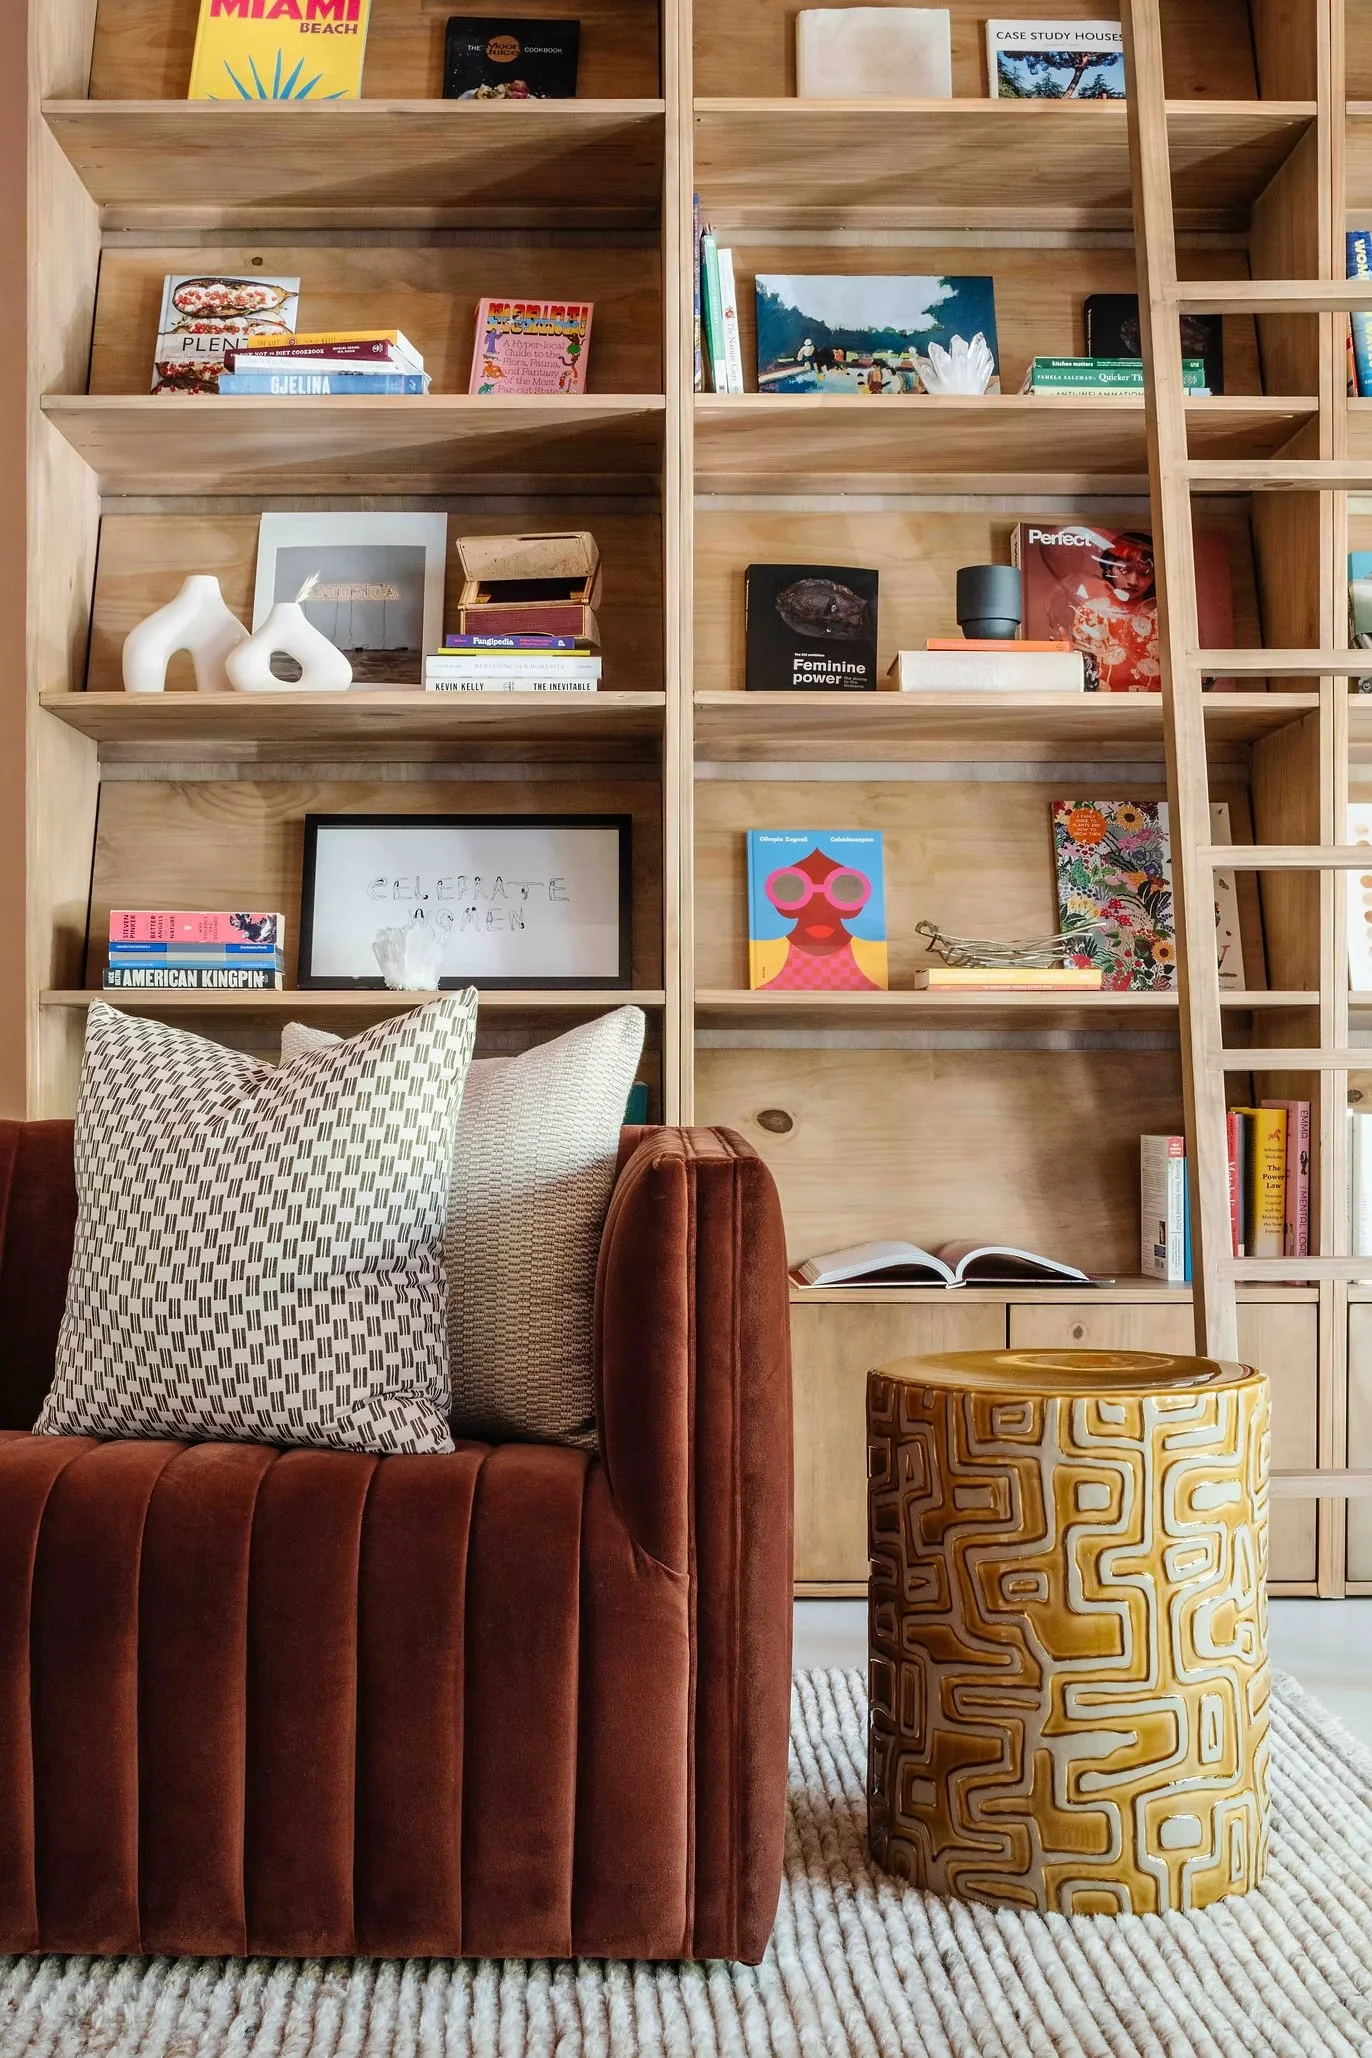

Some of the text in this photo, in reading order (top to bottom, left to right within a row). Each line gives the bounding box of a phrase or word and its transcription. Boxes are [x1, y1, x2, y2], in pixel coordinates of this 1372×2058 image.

[210, 0, 361, 21] MIAMI
[300, 23, 358, 34] BEACH
[996, 31, 1122, 41] CASE STUDY HOUSES
[1354, 239, 1369, 280] WOM
[503, 339, 565, 350] A Hyper-local
[728, 336, 736, 362] Nature
[291, 348, 325, 356] COOKBOOK
[505, 348, 532, 357] Guide
[545, 351, 560, 359] the
[503, 358, 561, 369] Flora, Fauna,
[503, 367, 560, 379] and Fantasy
[731, 363, 739, 382] Cure
[1098, 373, 1130, 383] Quicker
[1131, 373, 1143, 381] Th
[270, 375, 331, 395] GJELINA
[504, 376, 555, 386] of the Most
[534, 386, 559, 394] State
[1028, 529, 1092, 547] Perfect
[472, 637, 515, 646] Fungipedia
[793, 658, 866, 674] Feminine
[792, 673, 842, 685] power
[435, 682, 591, 691] KEVIN KELLY THE INEVITABLE
[367, 875, 571, 901] CELEBRATE
[408, 906, 526, 932] WOMEN
[122, 969, 264, 988] AMERICAN KINGPIN
[1300, 1109, 1309, 1139] EMMA
[1266, 1164, 1281, 1172] The
[1299, 1189, 1309, 1229] MENTAL
[1298, 1230, 1307, 1257] LOAD
